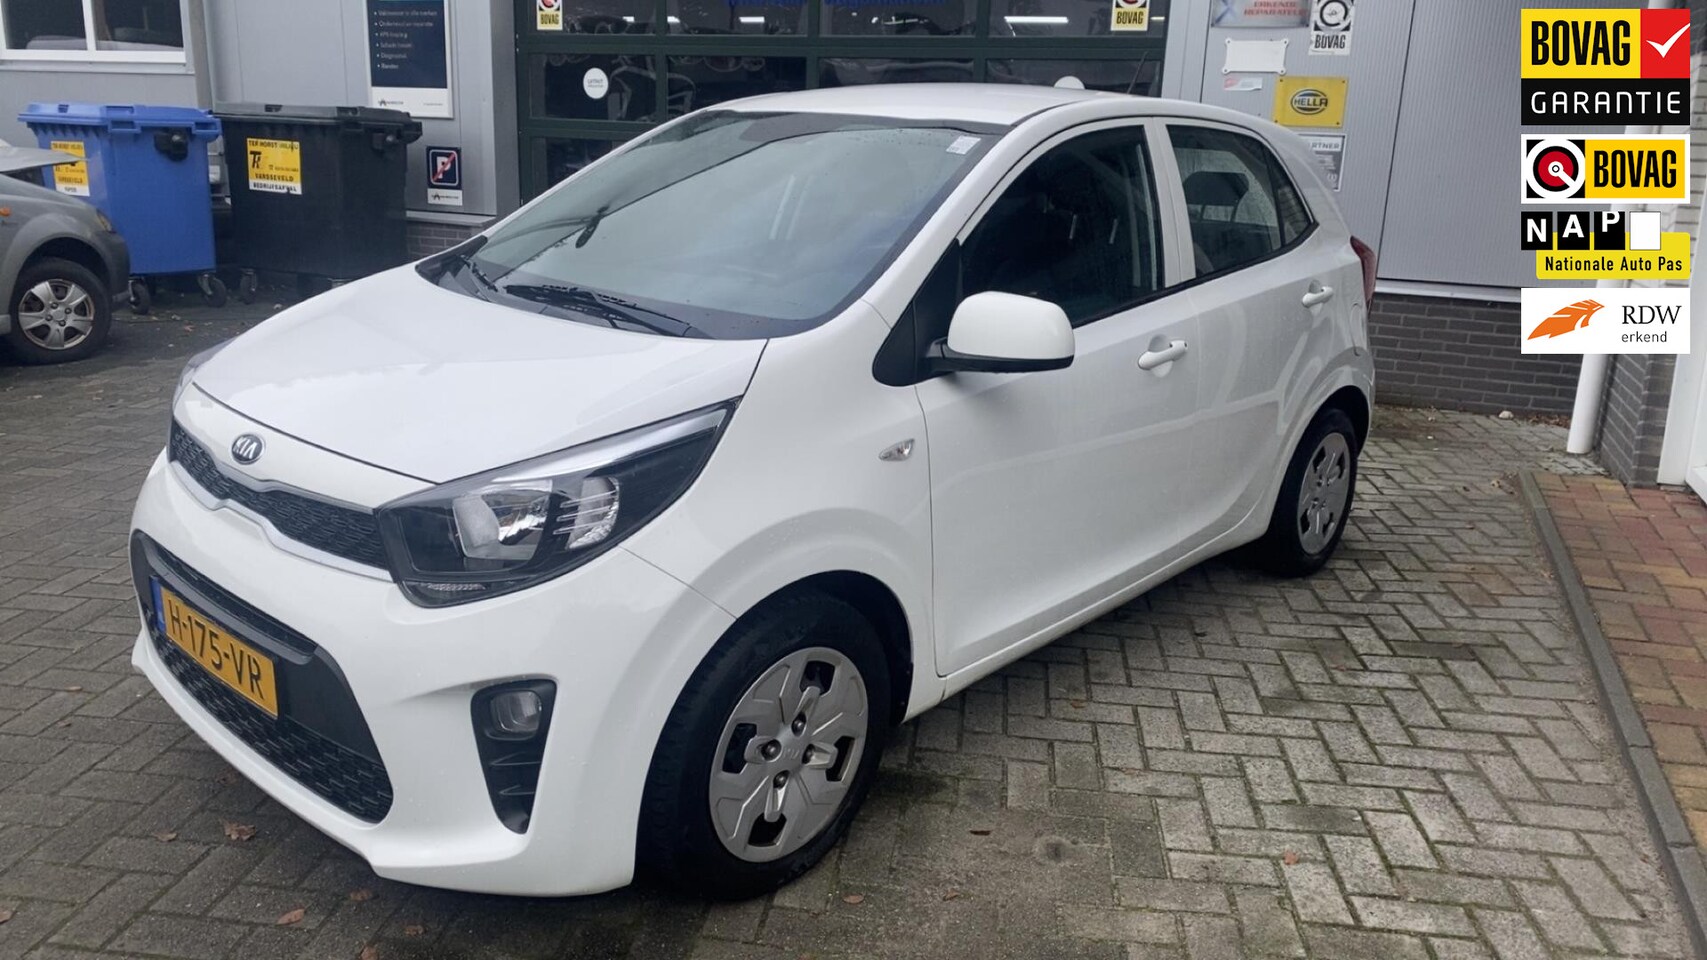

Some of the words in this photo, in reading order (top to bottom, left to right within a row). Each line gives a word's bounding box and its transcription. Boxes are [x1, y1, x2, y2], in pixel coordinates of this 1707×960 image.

[540, 13, 560, 25] BOVAG
[1116, 11, 1144, 24] BOVAG
[1294, 98, 1328, 107] HELLA
[1310, 142, 1340, 150] RTNER
[436, 156, 451, 179] P
[235, 436, 257, 460] KIA
[168, 599, 265, 700] H-175-VR
